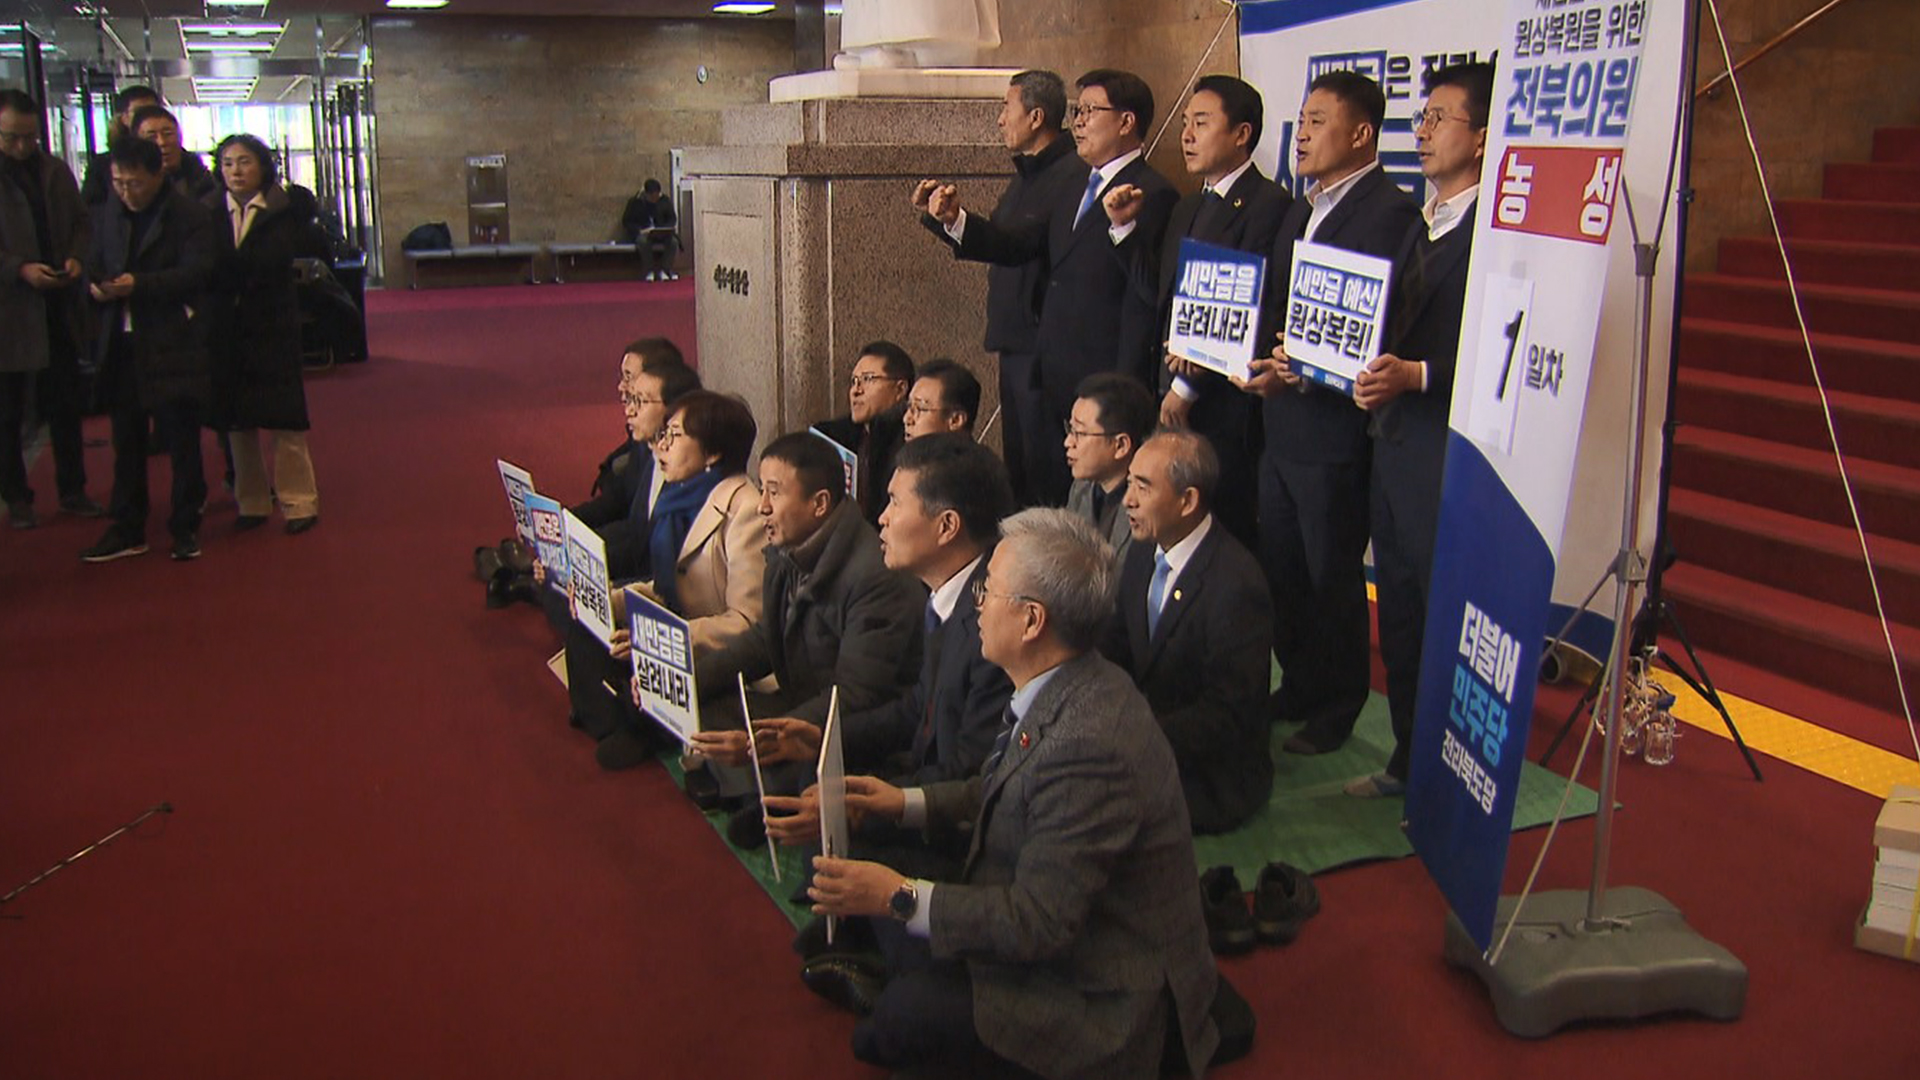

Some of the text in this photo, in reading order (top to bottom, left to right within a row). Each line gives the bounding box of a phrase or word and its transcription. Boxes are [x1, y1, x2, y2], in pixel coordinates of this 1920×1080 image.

[1513, 1, 1646, 58] 원상복원을 위한
[1503, 56, 1639, 137] 전북의원
[1180, 260, 1258, 304] 새만금을
[1294, 265, 1380, 317] 새만금 예산
[1176, 302, 1250, 345] 살려내라
[1289, 302, 1374, 363] 원상복원!
[1495, 310, 1564, 401] 1 일차
[632, 612, 688, 671] 새만금을
[1458, 600, 1521, 704] 더불어
[637, 655, 691, 713] 살려내라
[1450, 663, 1508, 768] 민주당
[1441, 729, 1497, 815] 전라북도당
